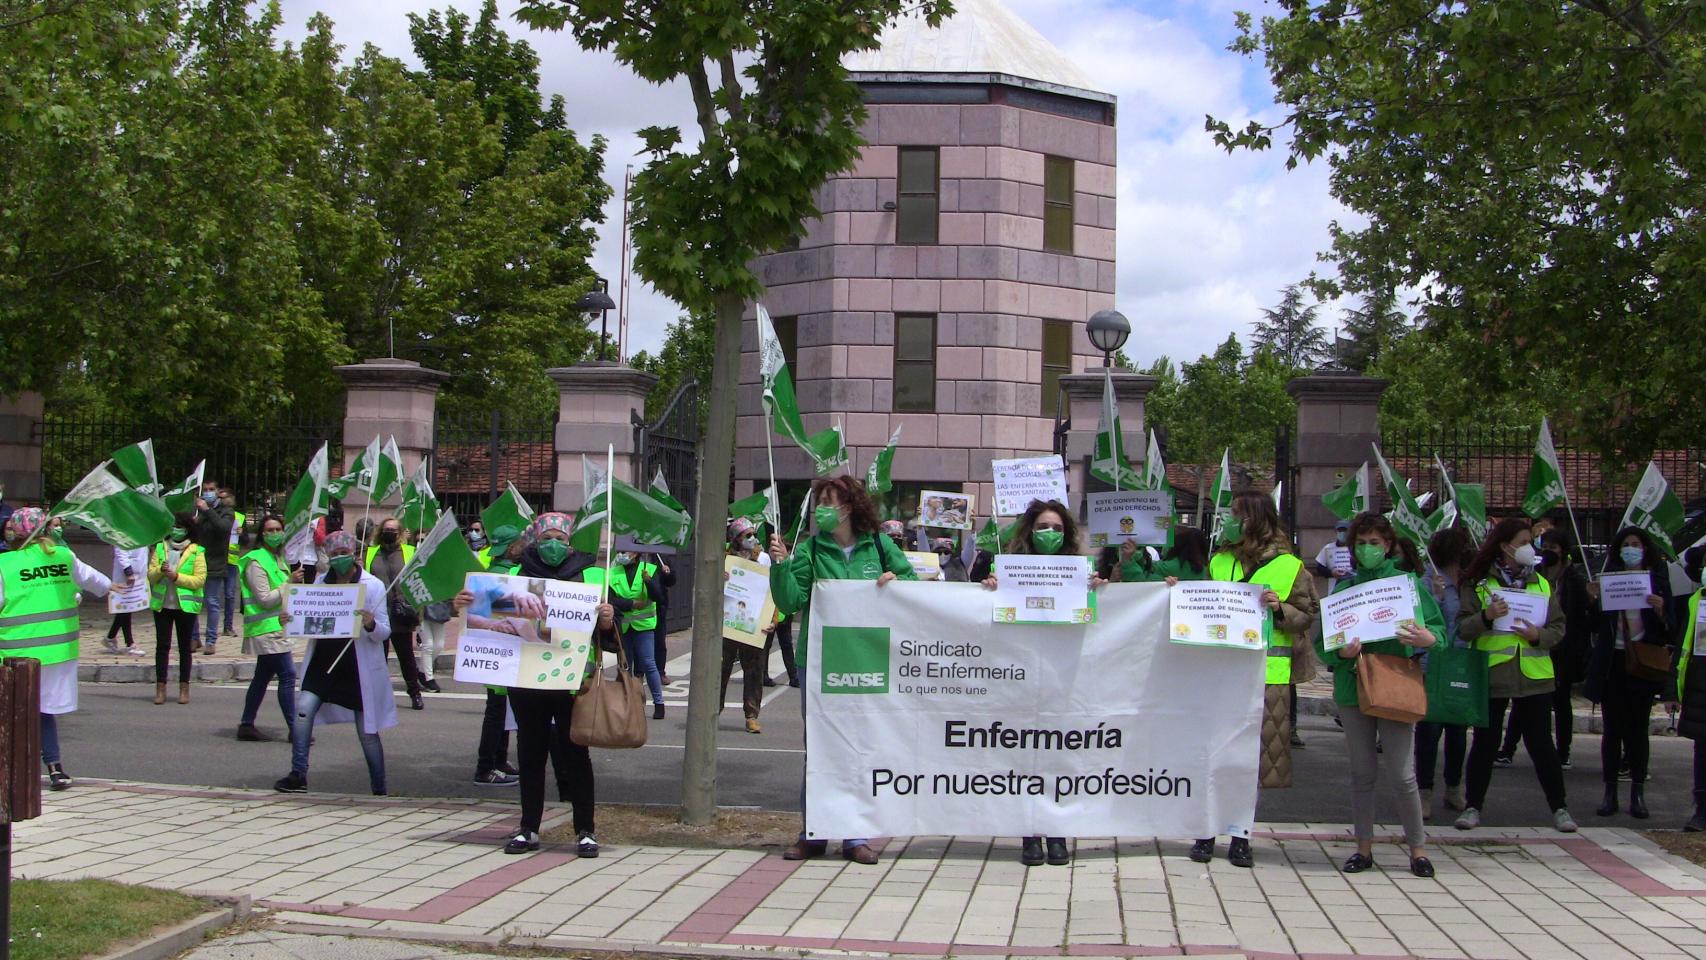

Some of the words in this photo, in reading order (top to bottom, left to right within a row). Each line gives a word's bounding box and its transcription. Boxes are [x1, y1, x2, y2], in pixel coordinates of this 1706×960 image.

[1011, 481, 1049, 489] ENFERMERAS
[1022, 489, 1057, 497] SANITARIOS
[20, 564, 69, 581] SATSE
[405, 571, 433, 605] SATSE
[545, 590, 599, 603] OLVIDAD@S
[1327, 593, 1364, 609] ENFERMERA
[1375, 586, 1402, 594] OFERTA
[1367, 595, 1403, 604] NOCTURNA
[548, 608, 591, 622] AHORA
[1227, 606, 1256, 614] SEGUNDA
[463, 645, 514, 658] OLVIDAD@S
[899, 640, 982, 657] Sindicato
[462, 658, 499, 671] ANTES
[899, 662, 921, 678] de
[926, 662, 1026, 681] Enfermería
[826, 672, 885, 688] SATSE
[898, 684, 912, 694] Lo
[916, 685, 938, 696] que
[941, 686, 962, 694] nos
[965, 686, 988, 695] une
[944, 720, 1123, 750] Enfermería
[871, 768, 925, 797] Por
[932, 769, 1045, 796] nuestra
[1055, 767, 1192, 803] profesión
